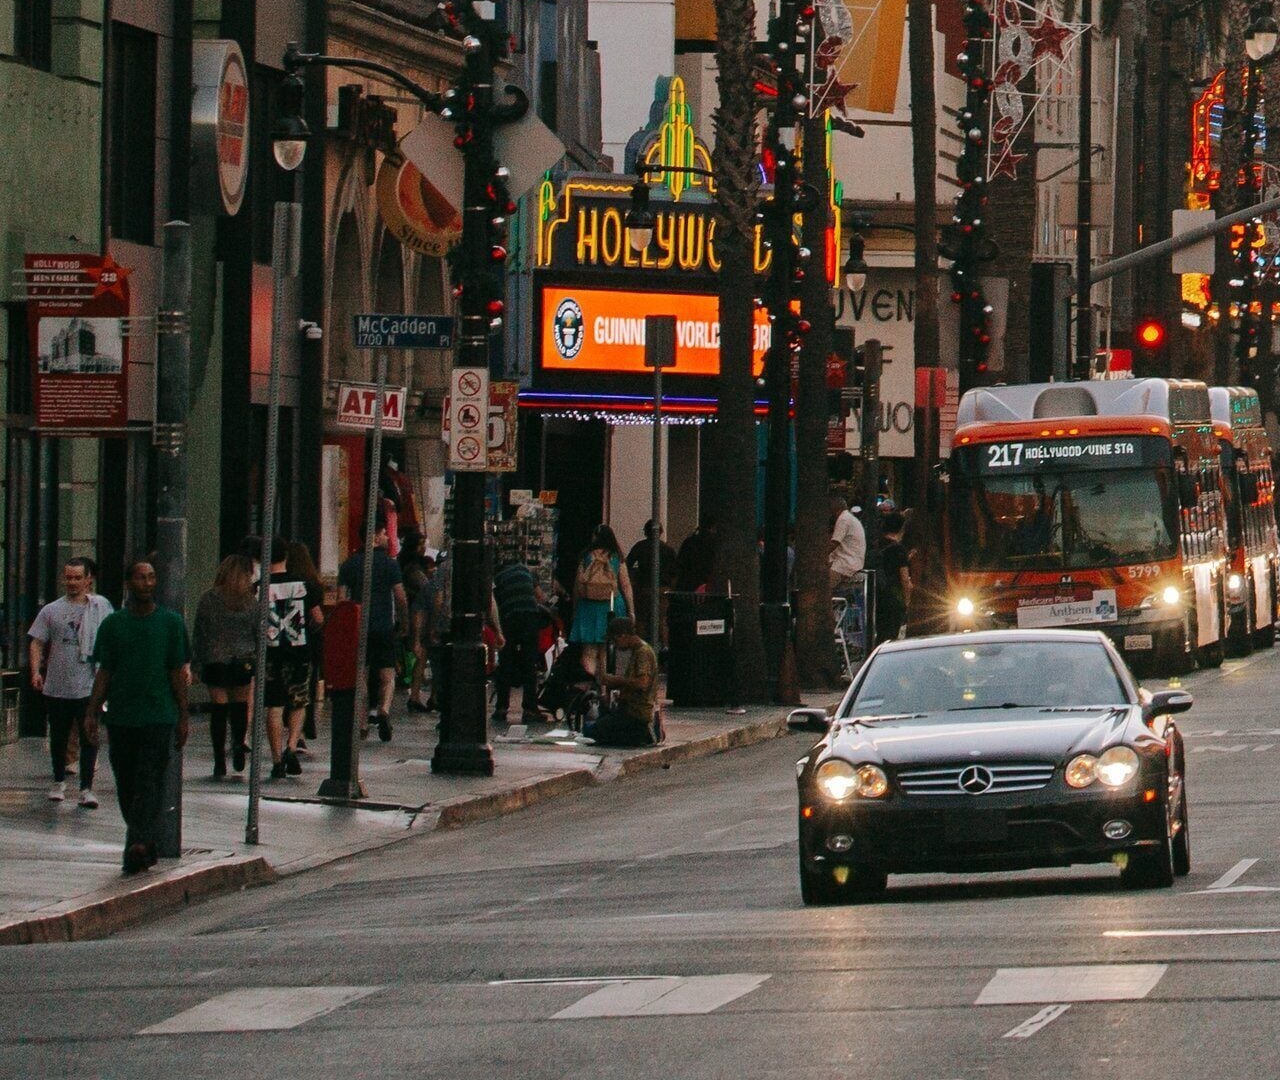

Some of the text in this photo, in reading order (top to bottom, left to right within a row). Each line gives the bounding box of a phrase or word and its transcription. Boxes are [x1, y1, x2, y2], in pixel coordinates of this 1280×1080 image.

[33, 260, 80, 269] HOLLYWOOD
[33, 274, 79, 283] HISTORIC
[358, 317, 437, 336] McCadden
[592, 316, 646, 346] GUINN
[358, 335, 383, 347] 1700
[387, 335, 396, 347] N
[342, 389, 399, 418] ATM
[988, 443, 1023, 468] 217
[1115, 443, 1134, 455] STA
[1128, 565, 1161, 578] 5799
[1018, 597, 1053, 607] Medicare
[1049, 605, 1092, 617] Anthem
